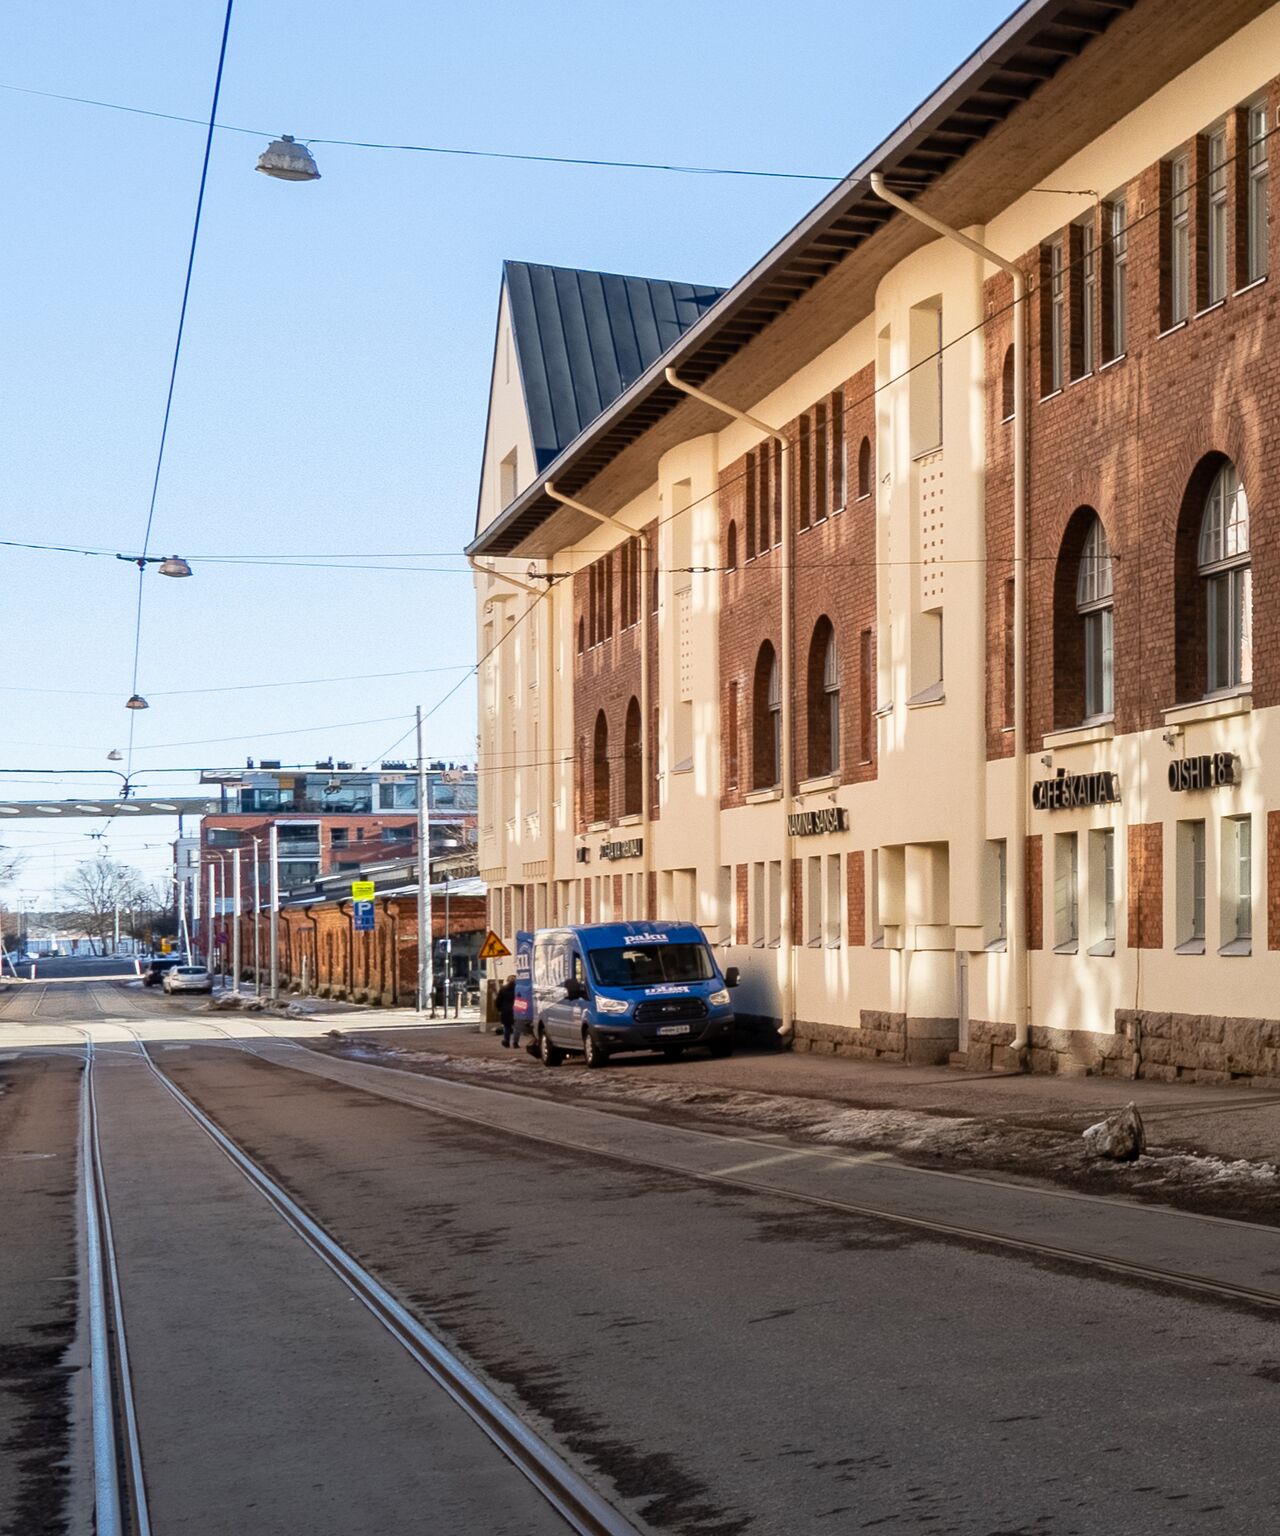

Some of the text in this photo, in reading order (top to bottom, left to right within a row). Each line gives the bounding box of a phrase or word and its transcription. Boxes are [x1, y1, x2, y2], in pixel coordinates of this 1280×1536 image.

[1168, 755, 1208, 792] OISHI
[1062, 771, 1111, 808] SKATTA
[358, 902, 372, 915] P
[624, 933, 668, 944] paku
